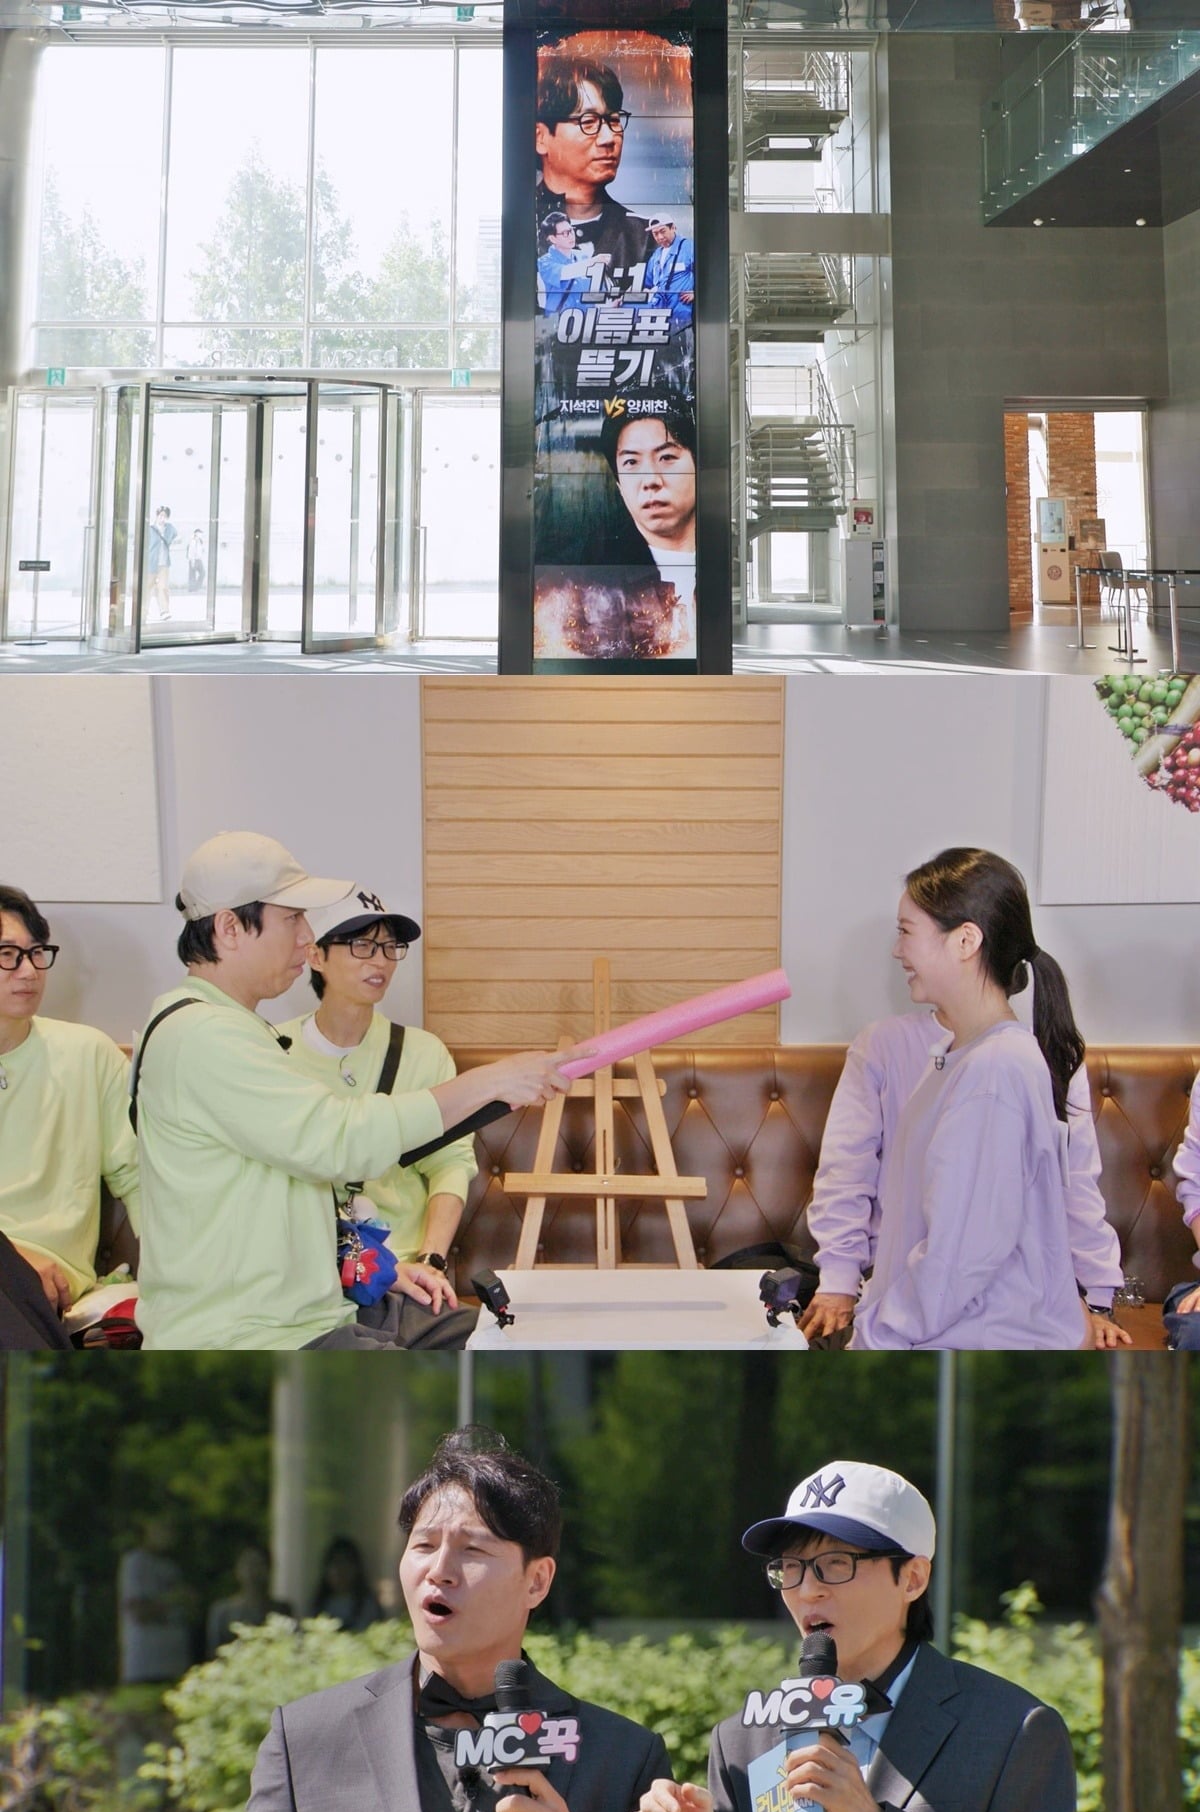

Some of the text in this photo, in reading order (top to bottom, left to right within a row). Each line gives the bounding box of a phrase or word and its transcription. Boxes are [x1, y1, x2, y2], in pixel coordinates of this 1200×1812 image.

[582, 262, 647, 303] 1:1
[557, 307, 672, 344] 이름표
[576, 349, 655, 387] 뜯기
[560, 395, 669, 418] 지석진 VS 양세찬
[800, 1473, 846, 1508] NY
[743, 1687, 813, 1726] MC
[456, 1725, 526, 1767] MC
